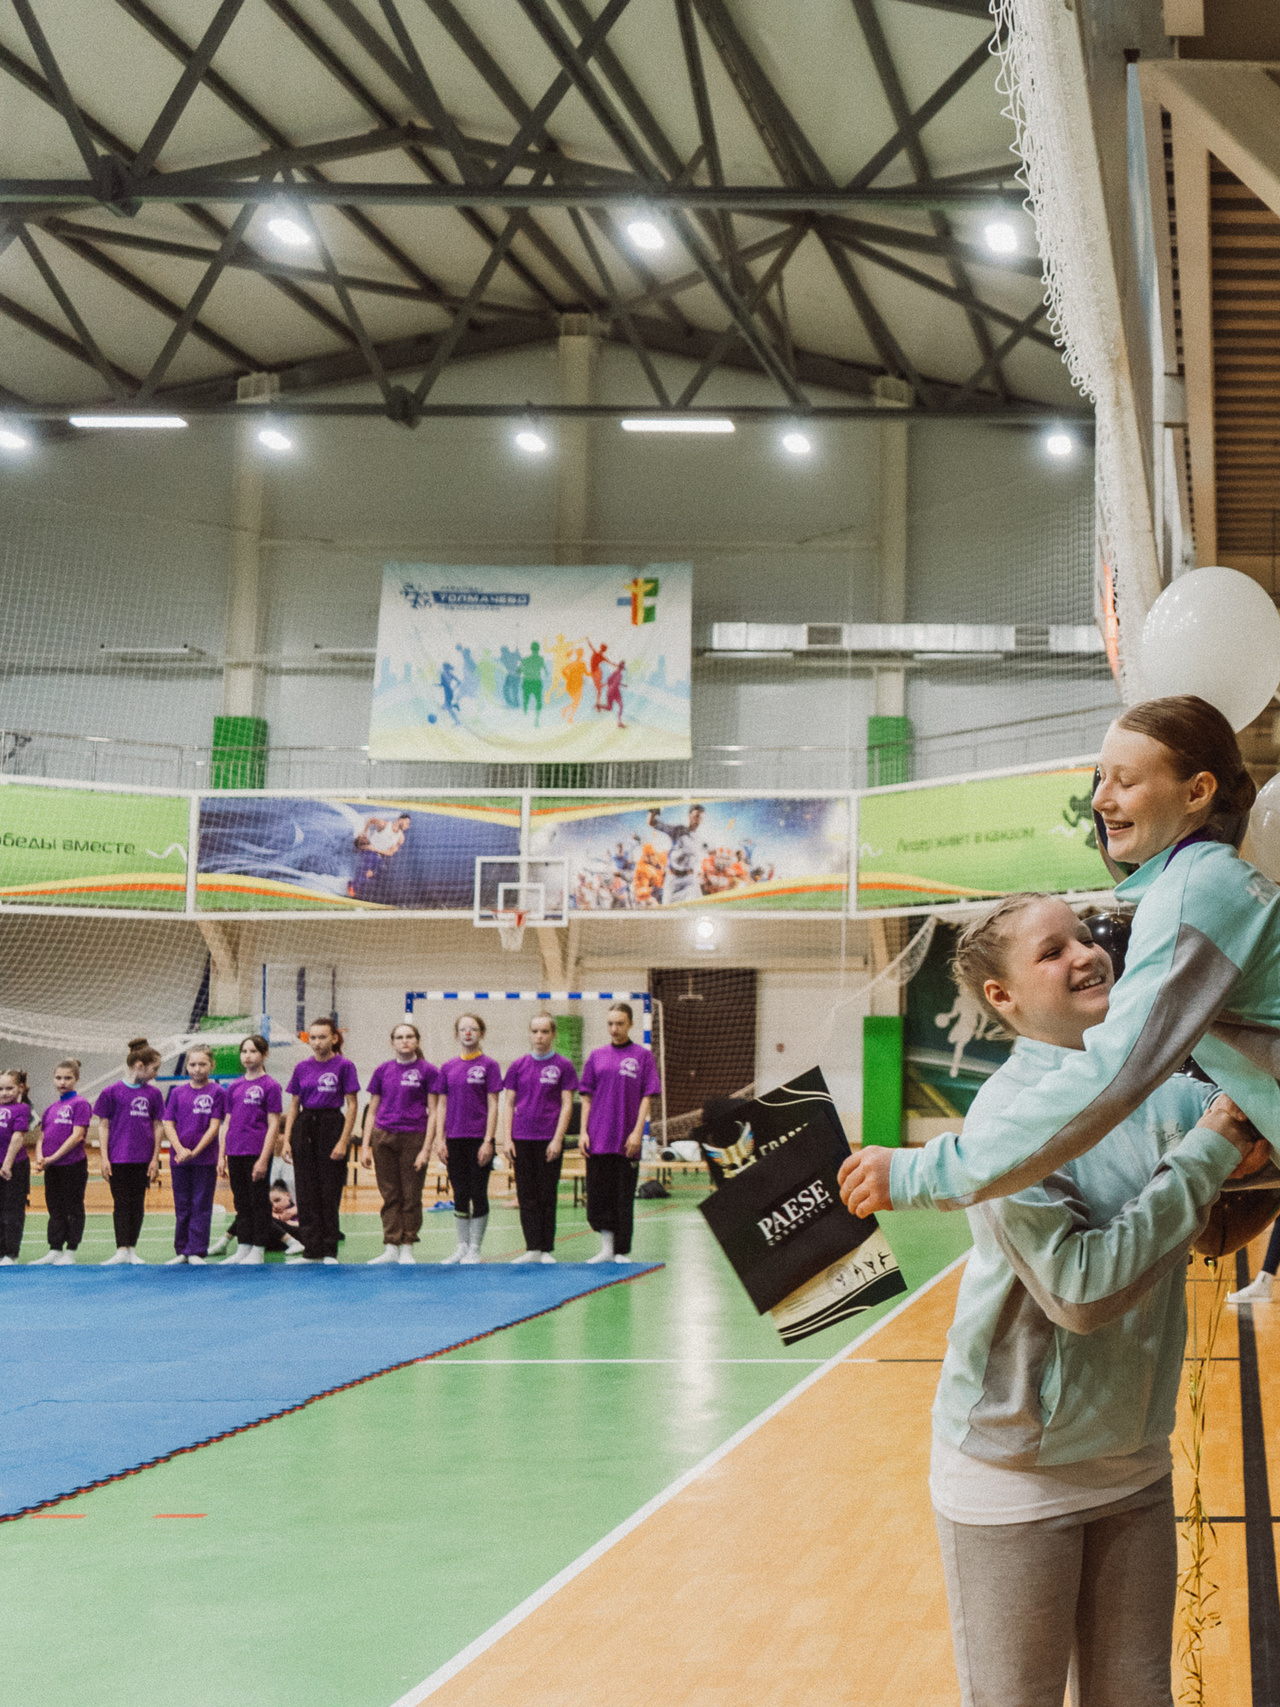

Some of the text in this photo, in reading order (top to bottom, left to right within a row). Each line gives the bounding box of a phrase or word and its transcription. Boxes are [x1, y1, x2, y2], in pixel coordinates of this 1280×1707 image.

[0, 832, 136, 855] беды вместе
[757, 1179, 830, 1241] PAESE
[767, 1197, 834, 1246] COSMETICS
